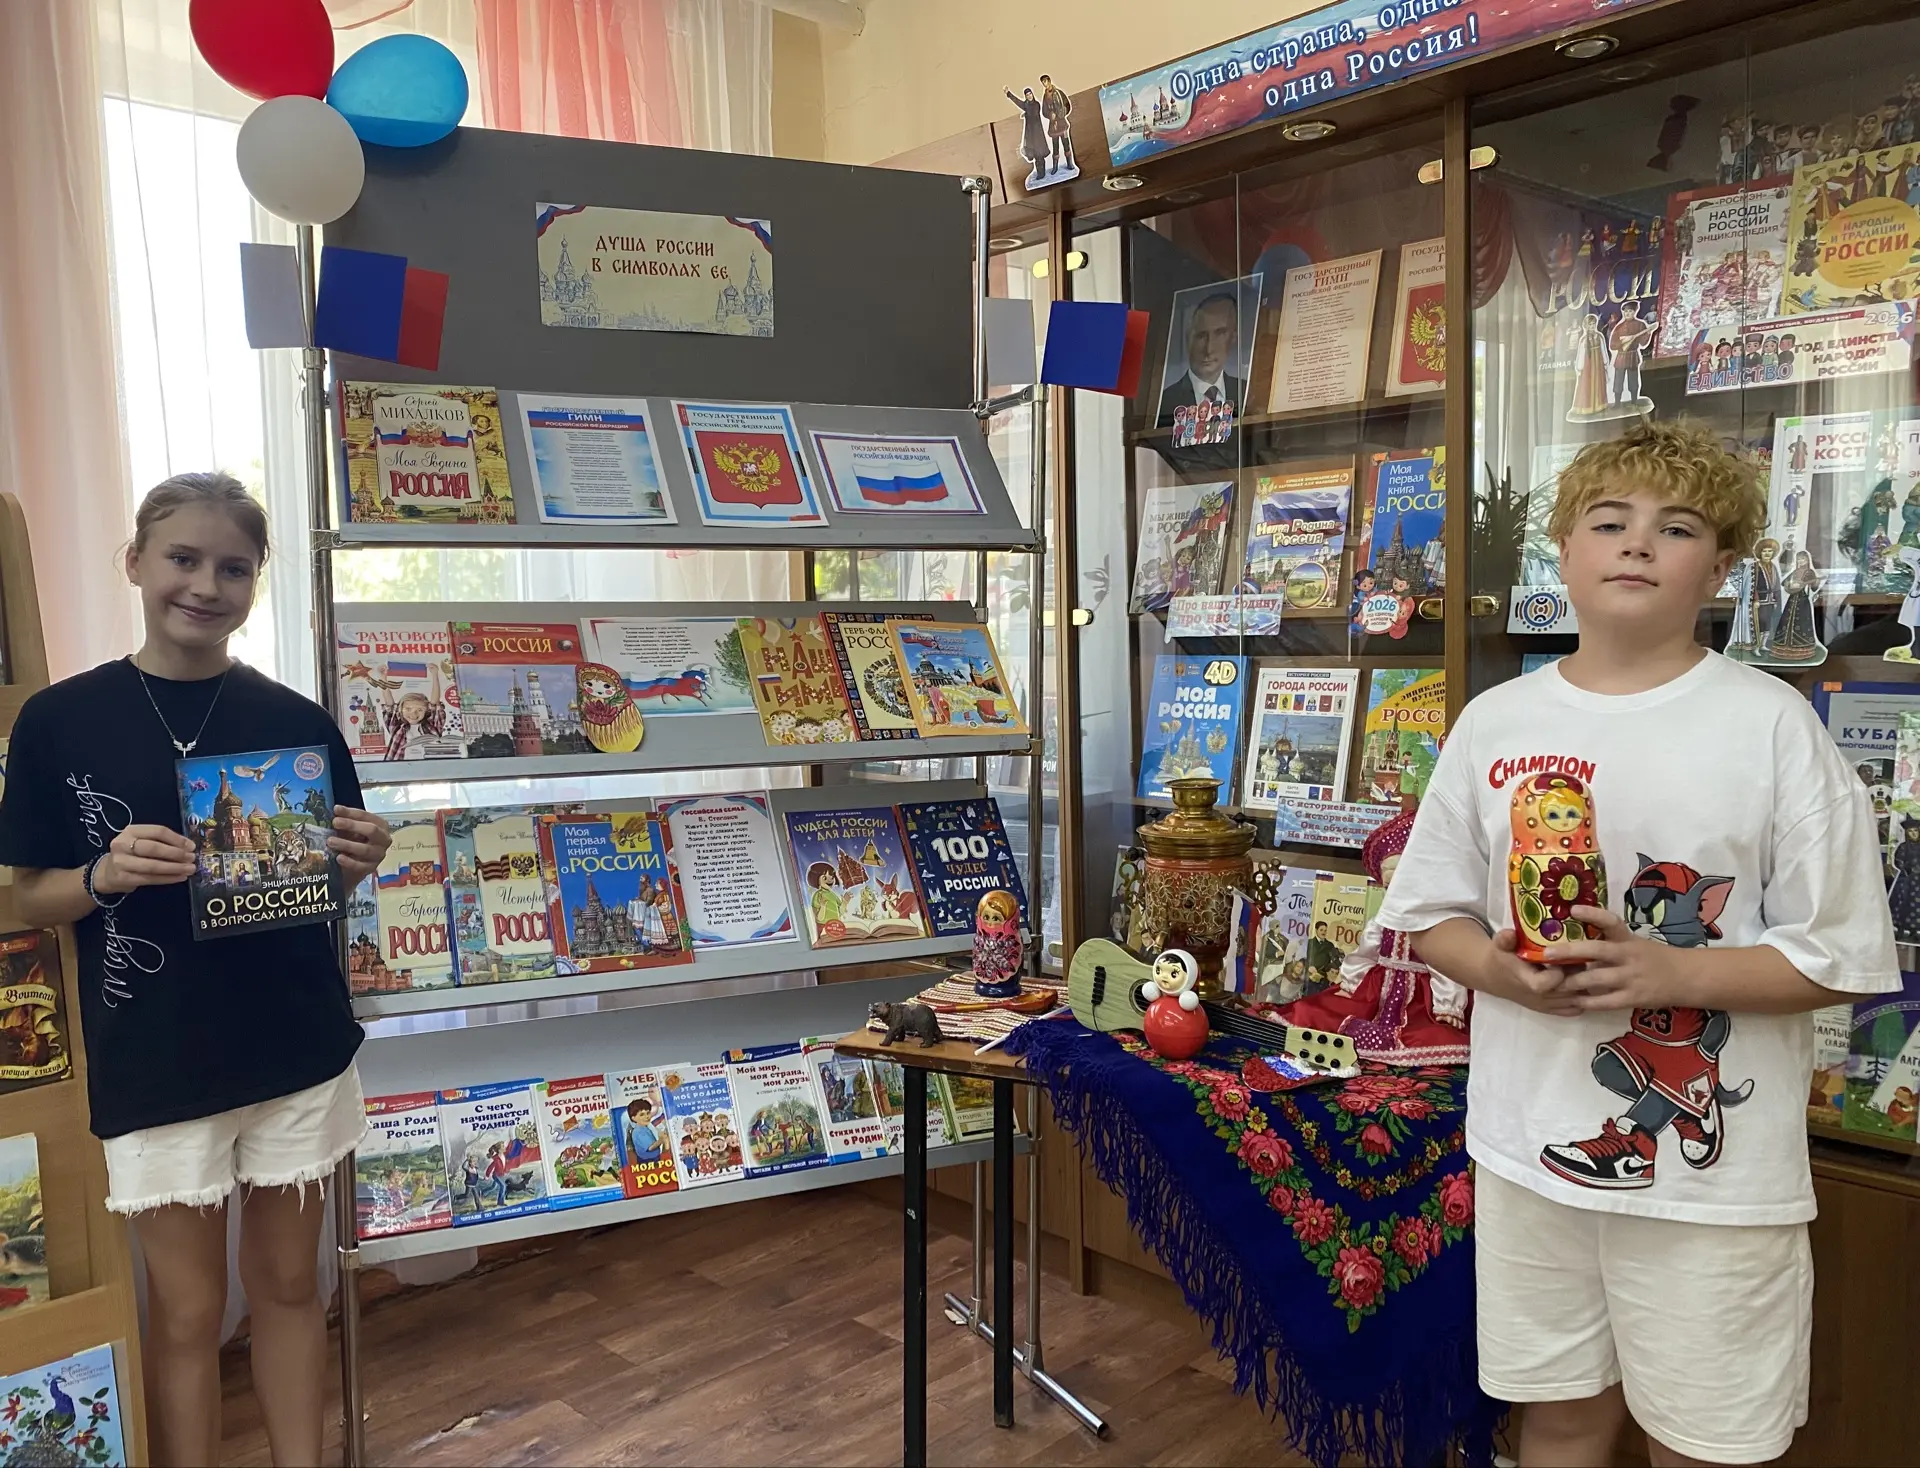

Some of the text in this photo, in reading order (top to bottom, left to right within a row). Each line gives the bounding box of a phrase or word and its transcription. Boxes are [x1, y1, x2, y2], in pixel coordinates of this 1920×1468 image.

[1171, 58, 1241, 100] Одна
[1252, 20, 1366, 73] страна,
[1265, 15, 1479, 107] одна Россия!
[1709, 203, 1770, 221] НАРОДЫ
[1708, 215, 1769, 232] РОССИИ
[1844, 215, 1894, 231] НАРОДЫ
[1697, 225, 1779, 243] ЭНЦИКЛОПЕДИЯ
[1842, 223, 1905, 241] ТРАДИЦИИ
[595, 235, 714, 257] ДУША РОССИИ
[1824, 232, 1909, 263] РОССИИ
[592, 257, 601, 272] В
[612, 258, 701, 277] СИМВОЛАХ
[1294, 259, 1372, 281] ГОСУДАРСТВЕННЫЙ
[1314, 272, 1349, 288] ГИМН
[1291, 279, 1370, 298] РОССИЙСКОЙ ФЕДЕРАЦИИ
[1864, 311, 1913, 327] 2026
[1750, 324, 1774, 332] Россия
[1794, 341, 1824, 354] ГОД
[1812, 346, 1887, 364] НАРОДОВ
[1818, 360, 1879, 377] РОССИИ
[1688, 363, 1794, 391] ЕДИНСТВО
[404, 396, 439, 409] Сергей
[381, 406, 465, 421] МИХАЛКОВ
[567, 413, 602, 422] ГИМН
[692, 412, 776, 420] ГОСУДАРСТВЕННЫЙ
[851, 445, 910, 453] ГОСУДАРСТВЕННЫЙ
[853, 452, 894, 460] РОССИЙСКОЙ
[384, 449, 468, 472] Моя Родина
[1389, 464, 1412, 475] Моя
[389, 470, 472, 499] РОССИЯ
[1388, 474, 1424, 486] первая
[1387, 485, 1415, 495] книга
[1377, 505, 1385, 514] о
[1256, 518, 1335, 537] Наша Родина
[1271, 532, 1324, 549] Россия
[1176, 597, 1281, 613] Про нашу Родину,
[1366, 599, 1398, 612] 2026
[1177, 612, 1231, 627] про нас
[357, 643, 451, 654] О ВАЖНО
[483, 637, 553, 652] РОССИЯ
[761, 641, 836, 680] НАШ
[1204, 661, 1238, 685] 4D
[1175, 686, 1217, 702] МОЯ
[1267, 681, 1348, 692] ГОРОДА РОССИИ
[1157, 702, 1232, 720] РОССИЯ
[1842, 727, 1898, 741] КУБА
[1488, 755, 1597, 789] CHAMPION
[1286, 799, 1295, 807] С
[1296, 802, 1347, 812] историей
[1295, 810, 1355, 823] С историей
[564, 827, 590, 837] Моя
[794, 817, 888, 834] ЧУДЕСА РОССИИ
[1300, 821, 1320, 830] Она
[566, 837, 606, 848] первая
[817, 828, 875, 842] ДЛЯ ДЕТЕЙ
[1287, 830, 1300, 839] На
[1303, 833, 1341, 844] подвиг
[567, 847, 600, 856] книга
[931, 835, 990, 863] 100
[560, 853, 662, 874] о РОССИИ
[946, 861, 988, 875] ЧУДЕС
[261, 873, 329, 889] ЭНЦИКЛОПЕДИЯ
[943, 876, 1000, 892] РОССИИ
[206, 883, 329, 916] О РОССИИ
[200, 900, 338, 929] В ВОПРОСАХ И ОТВЕТАХ
[1635, 1007, 1674, 1036] 23
[736, 1064, 780, 1075] Мой мир,
[770, 1069, 805, 1079] страна,
[616, 1073, 655, 1086] УЧЕБ
[680, 1085, 696, 1093] ЭТО
[474, 1102, 513, 1113] С чего
[545, 1097, 583, 1107] РАССКАЗЫ
[460, 1109, 530, 1125] начинается
[552, 1107, 562, 1117] О
[472, 1117, 521, 1131] Родина?
[386, 1127, 435, 1139] Россия
[829, 1127, 854, 1138] Стихи
[843, 1138, 850, 1146] о
[631, 1161, 655, 1173] МОЯ
